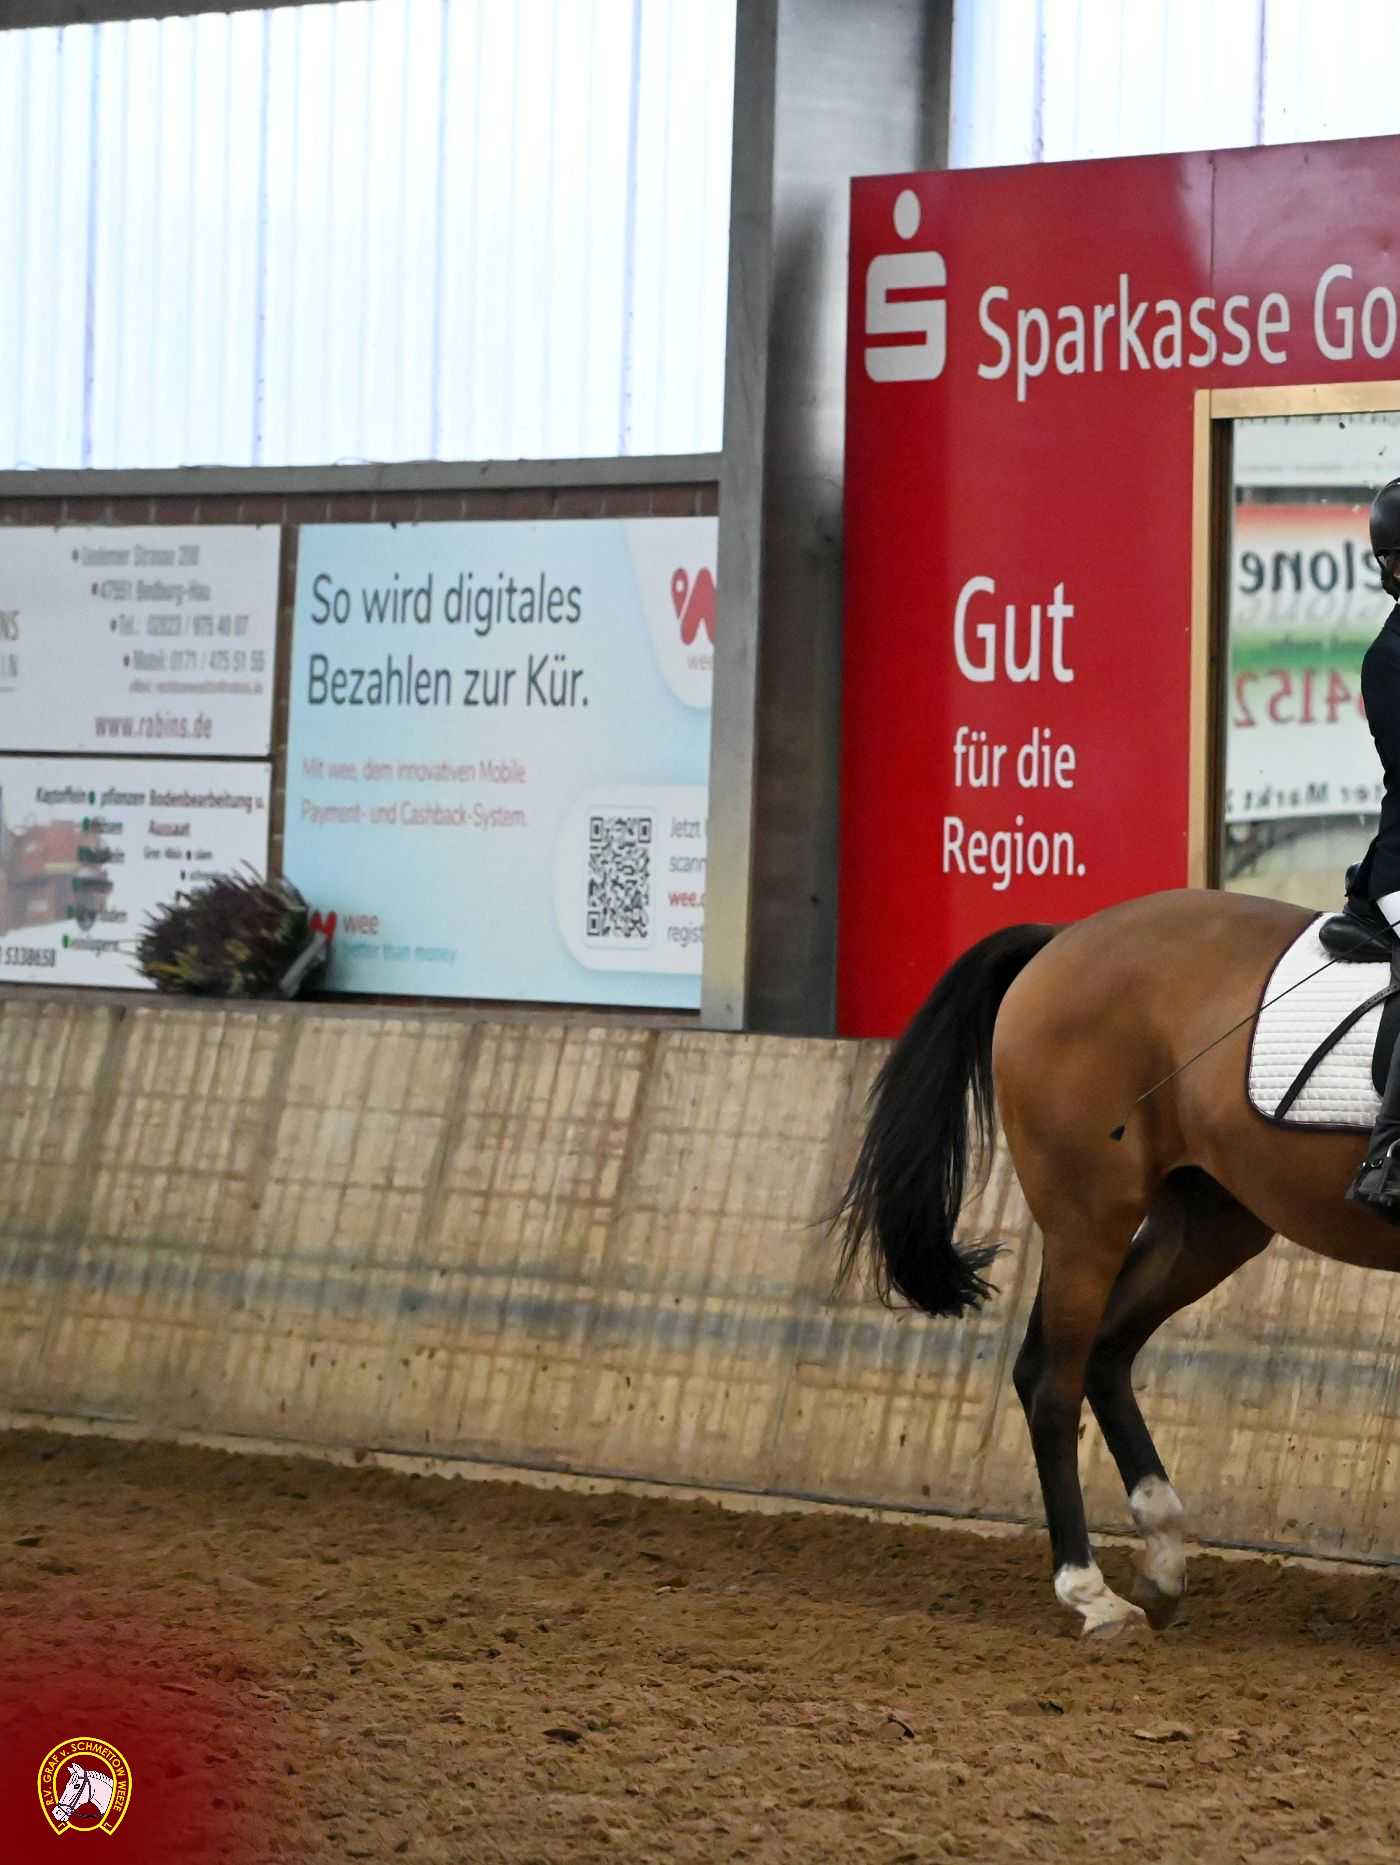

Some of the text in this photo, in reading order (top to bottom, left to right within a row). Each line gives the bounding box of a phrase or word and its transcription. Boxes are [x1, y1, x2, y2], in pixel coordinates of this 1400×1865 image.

[976, 273, 1291, 402] Sparkasse
[311, 571, 583, 637] So wird digitales
[953, 575, 1075, 683] Gut
[308, 653, 589, 708] Bezahlen zur Kür.
[95, 713, 213, 740] www.rabins.de
[362, 757, 393, 781] dem
[397, 759, 477, 783] innovativen
[479, 759, 528, 784] Mobile
[953, 726, 1077, 789] für die
[369, 801, 397, 825] und
[942, 814, 1087, 891] Region.
[343, 915, 380, 936] wee
